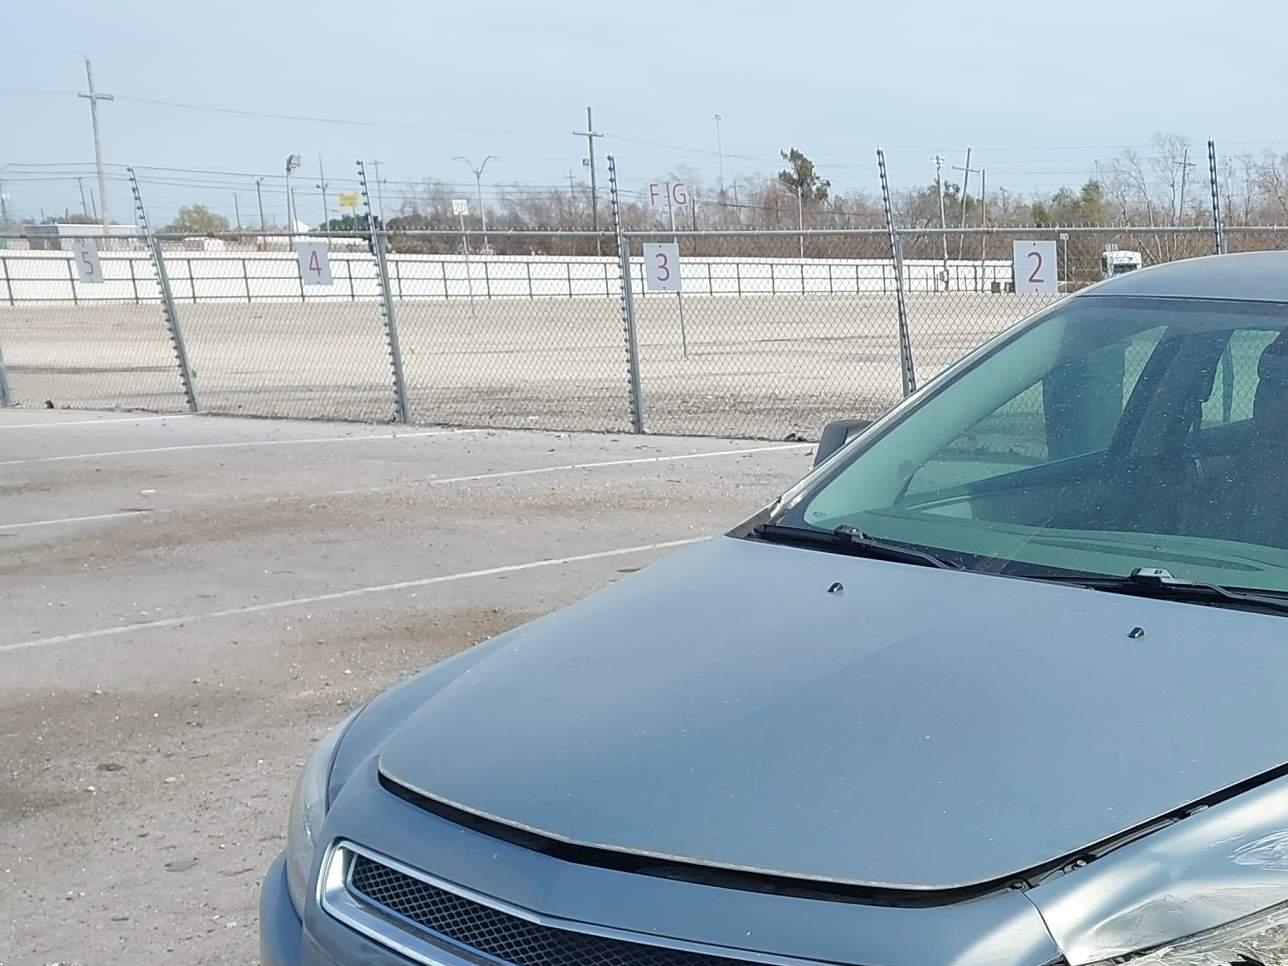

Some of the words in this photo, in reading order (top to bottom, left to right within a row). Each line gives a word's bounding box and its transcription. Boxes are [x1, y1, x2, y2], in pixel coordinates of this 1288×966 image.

[648, 183, 660, 206] F
[672, 183, 687, 205] G
[81, 251, 94, 275] 5
[309, 250, 322, 277] 4
[655, 253, 670, 281] 3
[1027, 251, 1044, 283] 2
